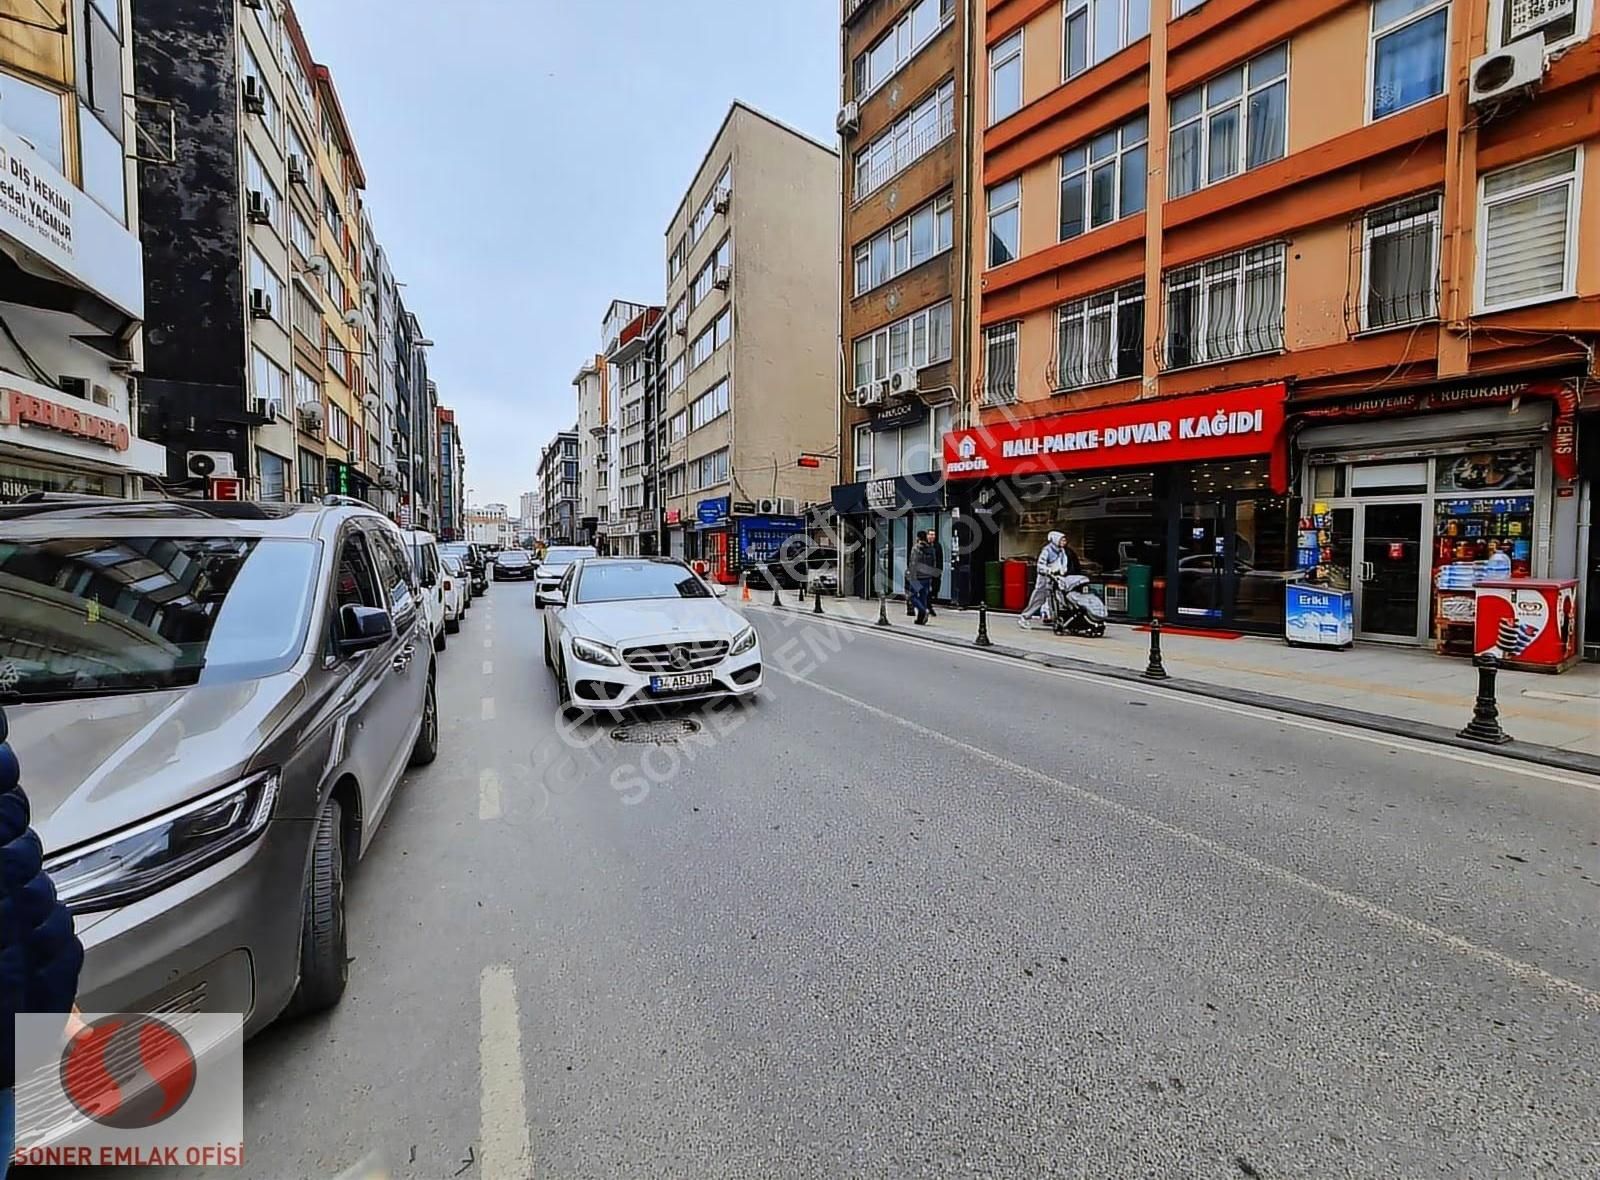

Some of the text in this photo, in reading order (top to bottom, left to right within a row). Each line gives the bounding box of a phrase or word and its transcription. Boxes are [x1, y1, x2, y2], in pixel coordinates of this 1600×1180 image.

[0, 181, 26, 208] edat
[29, 197, 72, 241] YAĞMUR
[10, 157, 71, 218] DİŞ HEKİMİ
[1178, 408, 1264, 441] KAĞIDI
